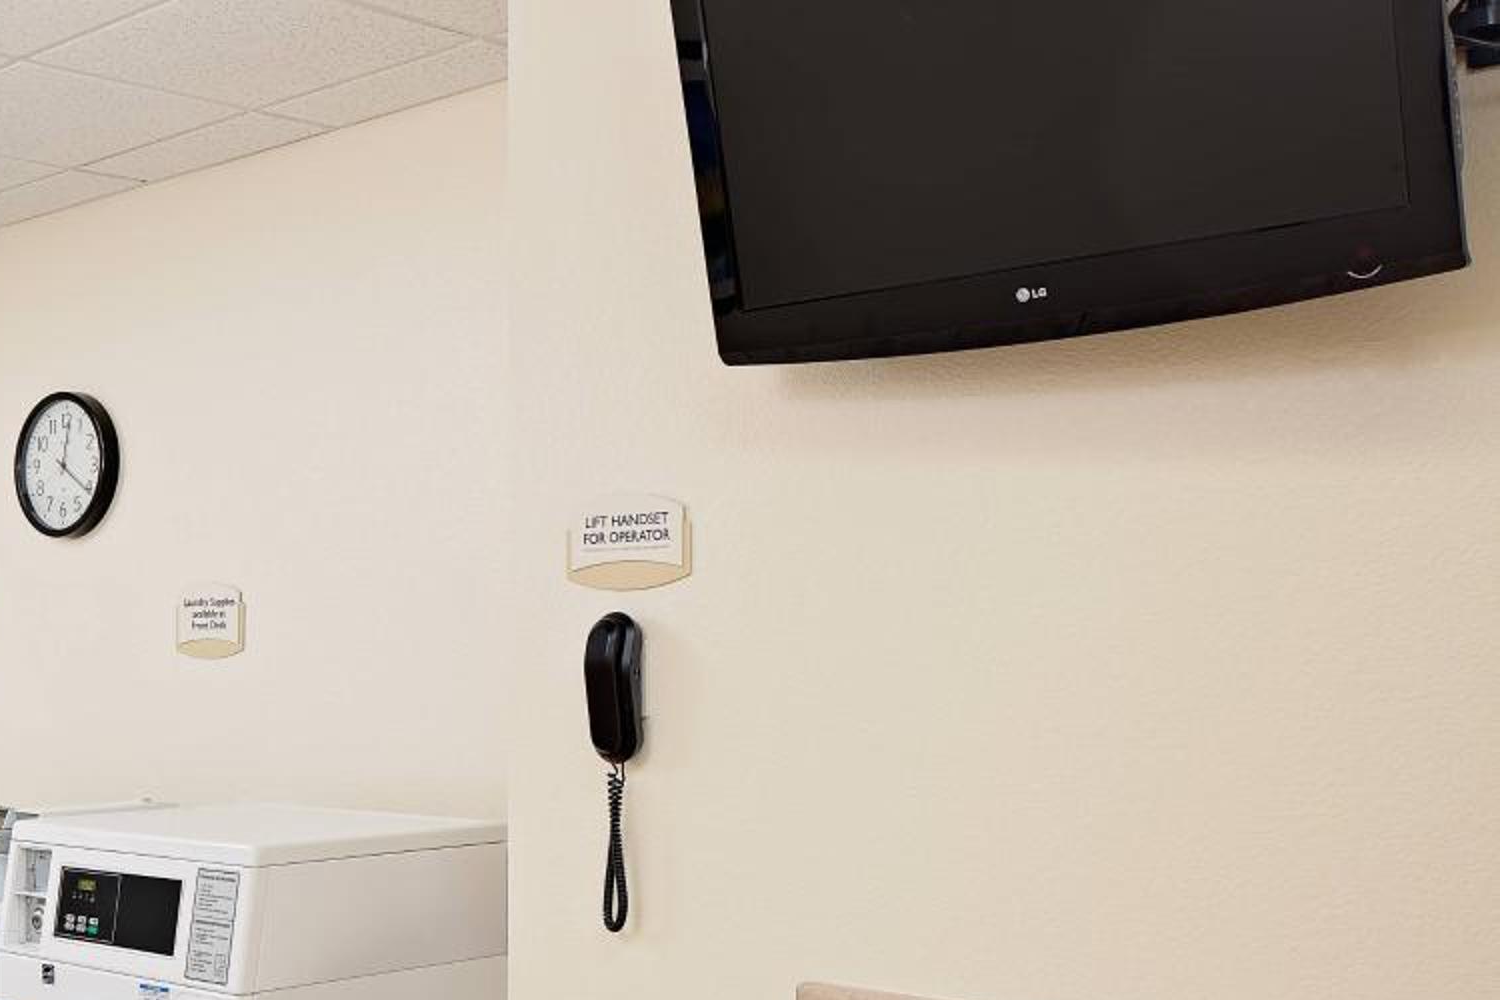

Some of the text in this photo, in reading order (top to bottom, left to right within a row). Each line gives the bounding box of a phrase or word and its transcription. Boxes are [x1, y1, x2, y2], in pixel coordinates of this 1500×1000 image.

[1031, 287, 1047, 299] LG
[49, 419, 57, 435] 11
[61, 413, 72, 430] 12
[37, 435, 49, 453] 10
[85, 433, 95, 450] 2
[33, 459, 41, 475] 9
[36, 480, 45, 496] 8
[46, 495, 54, 512] 7
[59, 502, 67, 518] 6
[73, 495, 83, 512] 5
[585, 512, 669, 529] LIFT HANDSET
[583, 529, 670, 545] FOR OPERATOR
